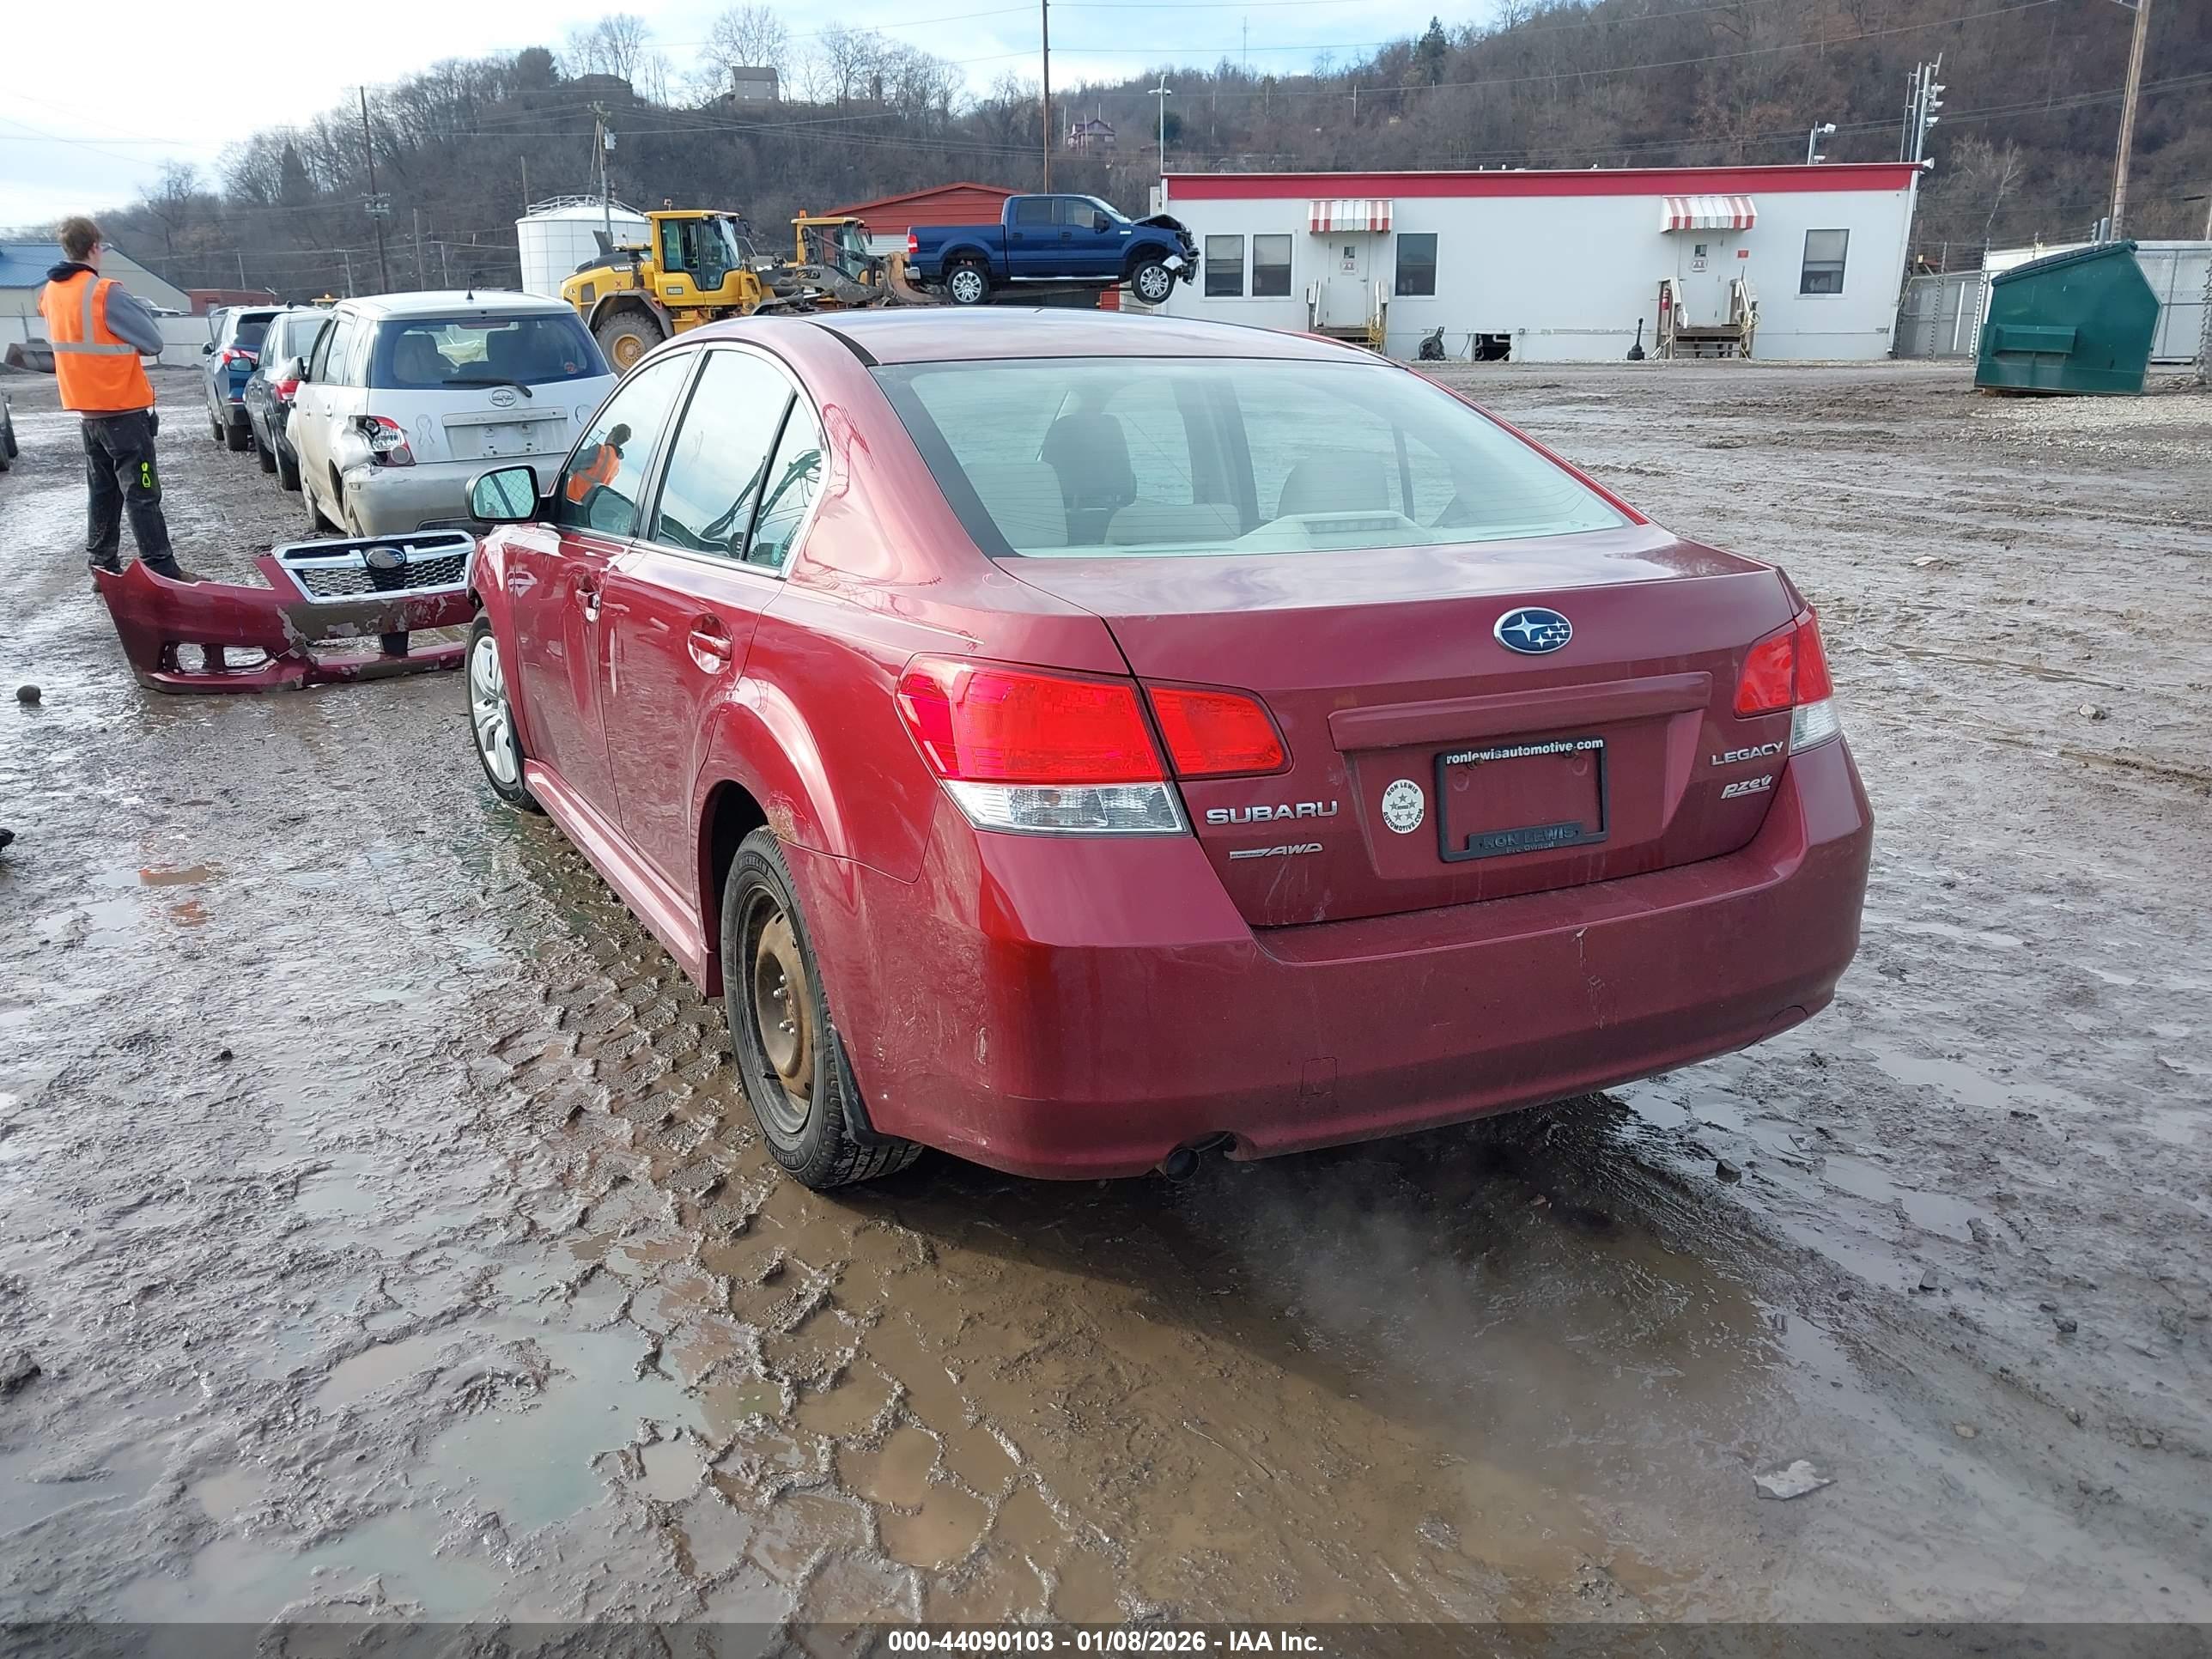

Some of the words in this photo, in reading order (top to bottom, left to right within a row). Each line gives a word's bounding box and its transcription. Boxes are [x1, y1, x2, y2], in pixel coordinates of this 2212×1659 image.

[1446, 739, 1604, 764] ronlewisautomotive.com
[1711, 741, 1784, 766] LEGACY
[1386, 784, 1399, 797] RON
[1400, 782, 1419, 794] LEWIS
[1206, 800, 1338, 825] SUBARU
[1383, 808, 1423, 831] AUTOMOTIVE.COM
[1266, 842, 1323, 857] AWD
[1484, 832, 1519, 850] RON
[1524, 824, 1574, 845] LEWIS
